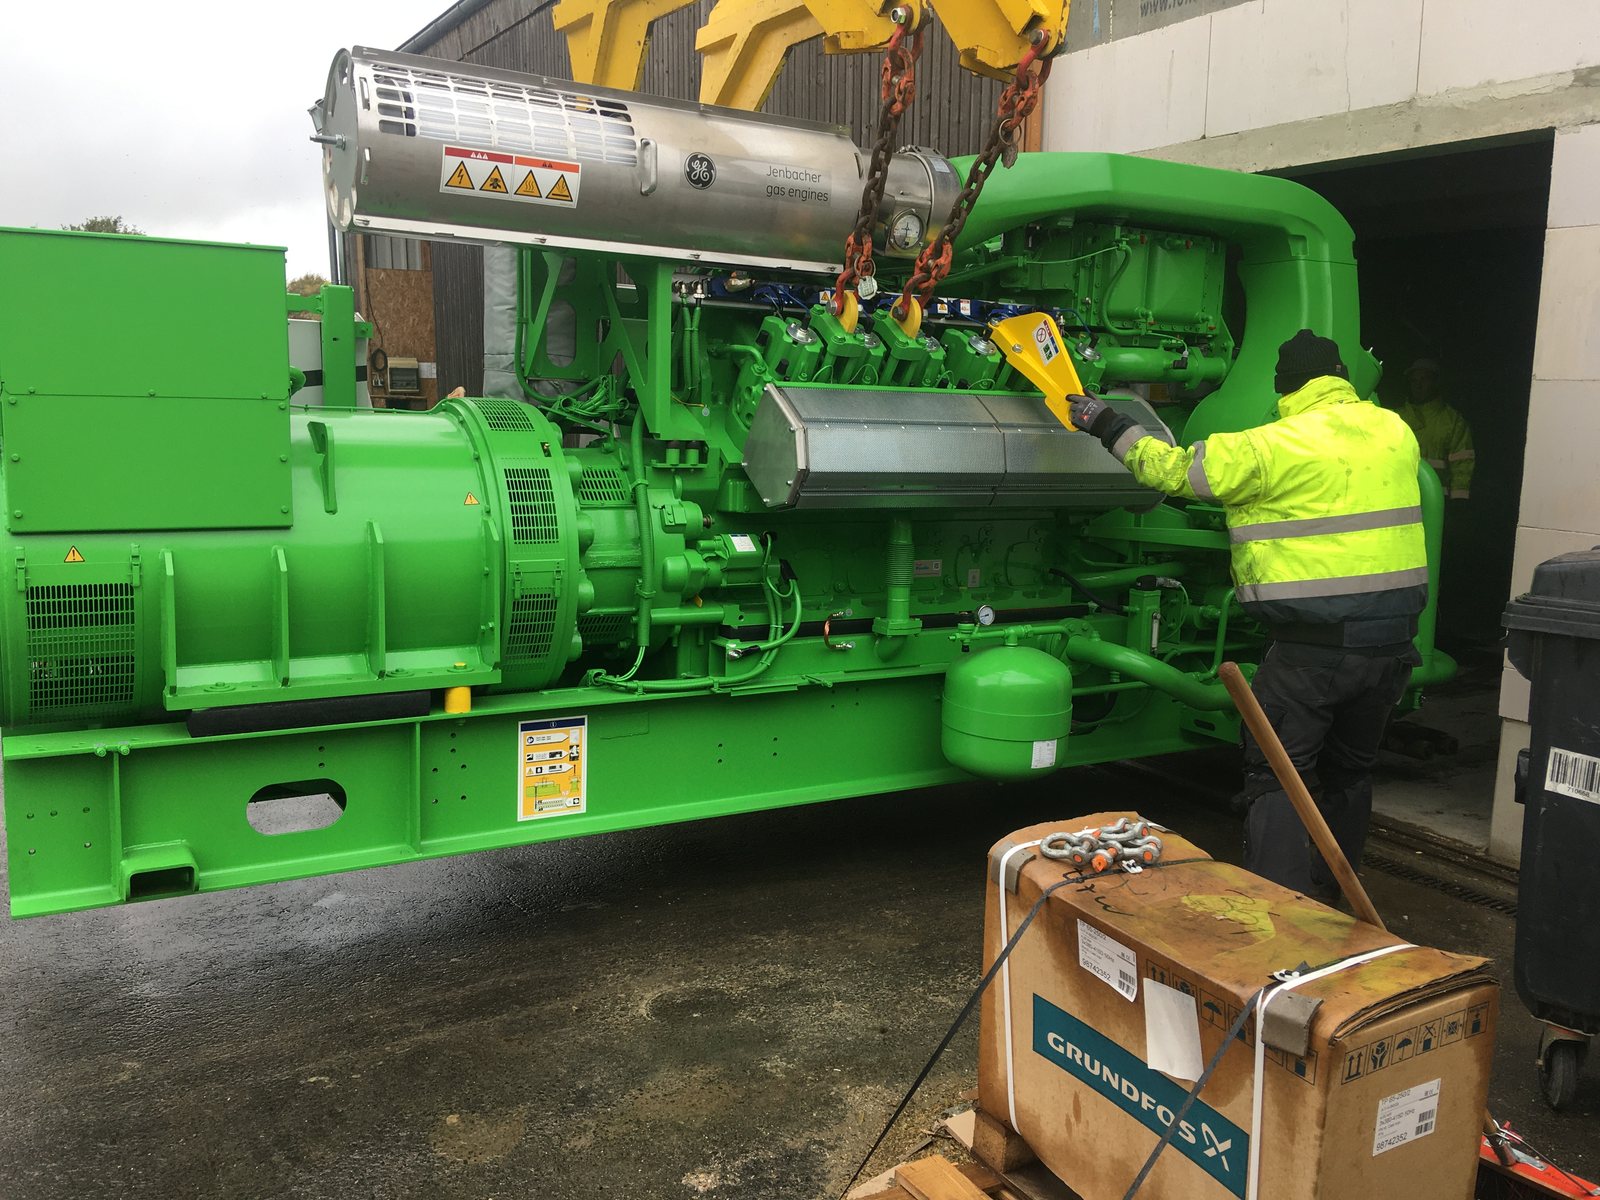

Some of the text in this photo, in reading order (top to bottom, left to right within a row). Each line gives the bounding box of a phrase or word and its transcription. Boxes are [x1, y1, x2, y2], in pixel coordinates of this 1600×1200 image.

[766, 165, 822, 183] Jenbacher
[766, 184, 829, 202] gas engines
[1047, 1031, 1197, 1144] GRUNDFOS
[1376, 1132, 1408, 1151] 98742352
